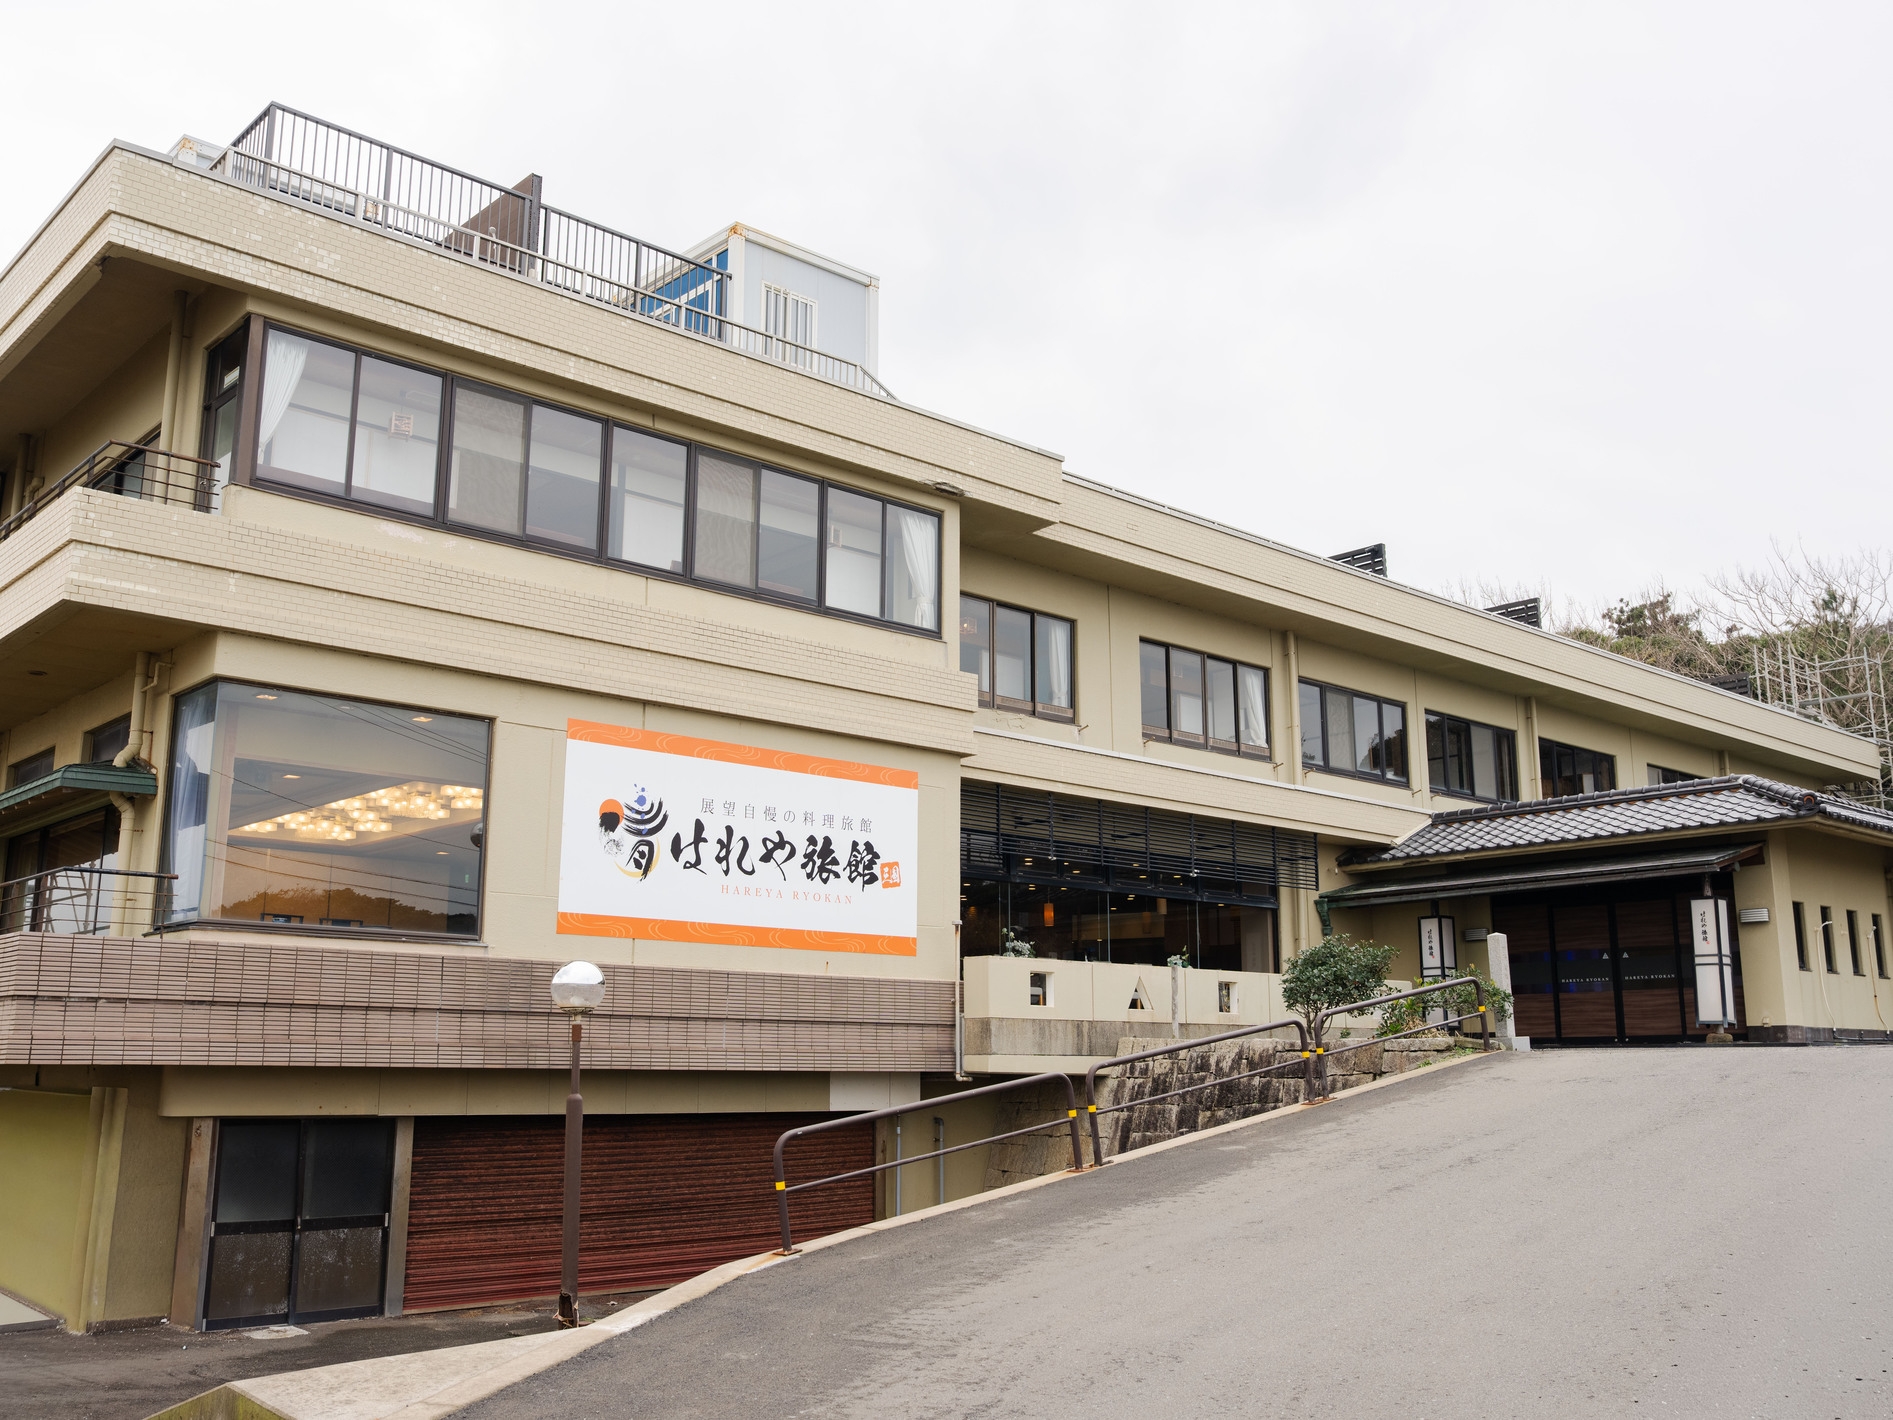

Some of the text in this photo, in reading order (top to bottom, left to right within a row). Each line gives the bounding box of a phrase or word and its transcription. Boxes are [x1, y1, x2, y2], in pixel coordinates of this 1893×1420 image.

[700, 797, 873, 834] 展望自慢の料理旅館
[670, 818, 881, 892] はれや旅館
[721, 884, 853, 905] HAREYA RYOKAN
